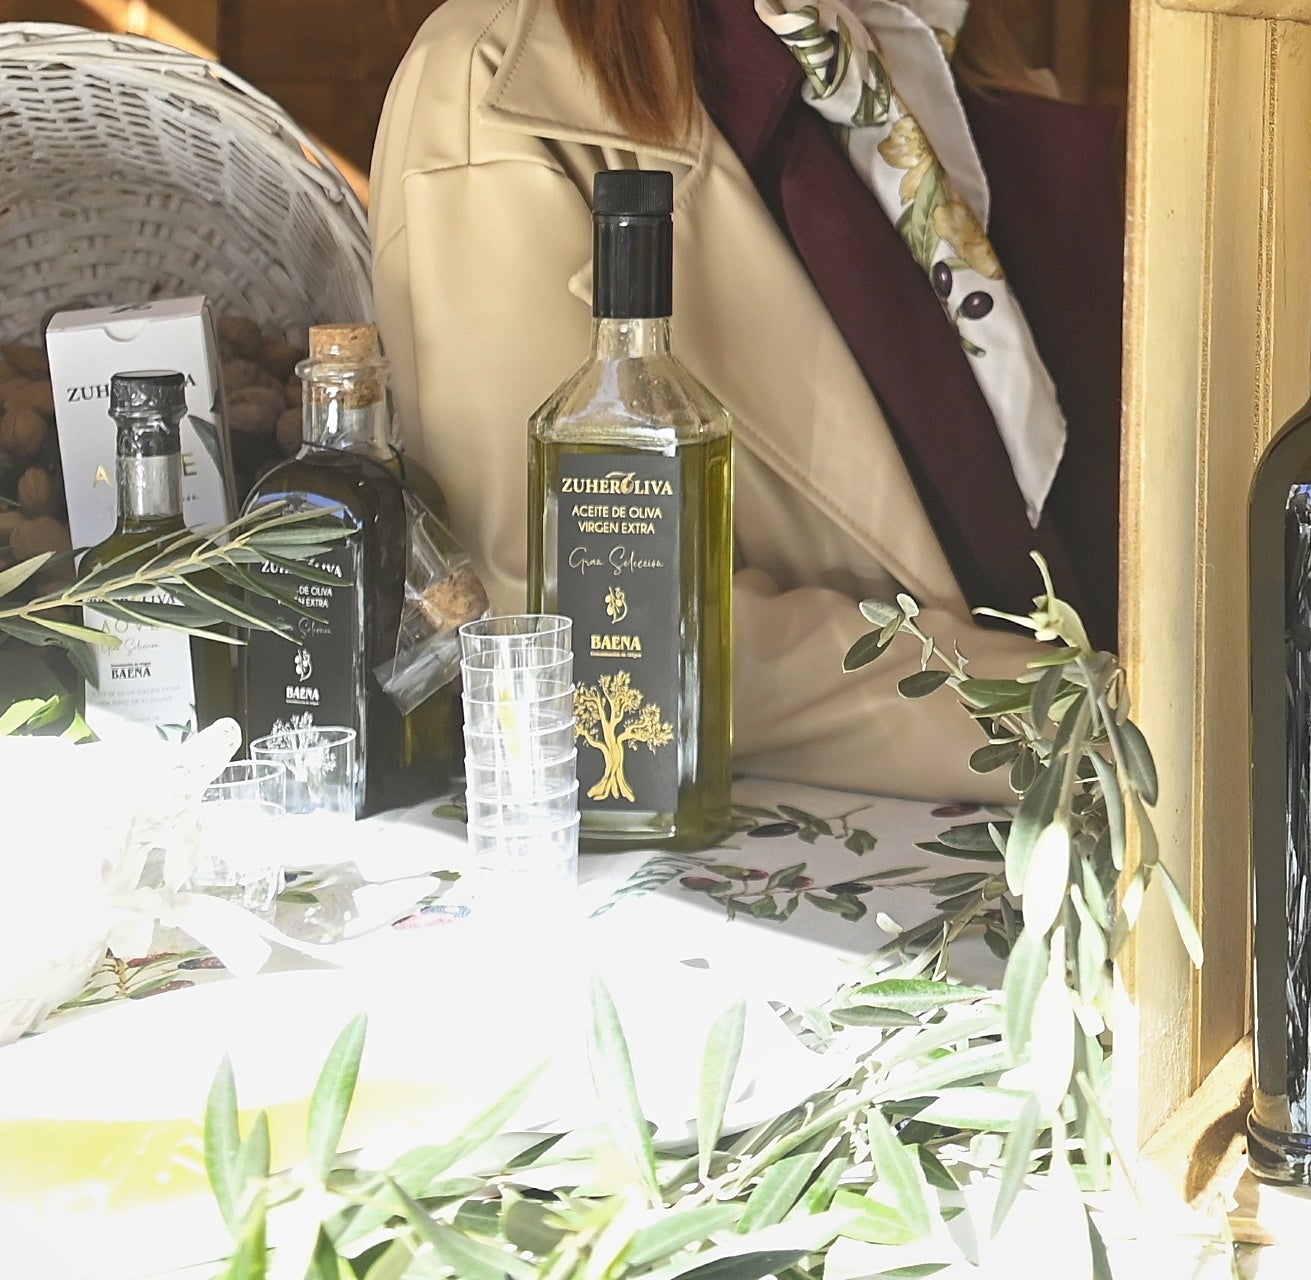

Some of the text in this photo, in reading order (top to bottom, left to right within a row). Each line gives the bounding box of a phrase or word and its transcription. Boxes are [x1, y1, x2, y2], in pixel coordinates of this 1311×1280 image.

[561, 472, 674, 496] ZUHEROLIVA
[572, 505, 663, 520] ACEITE DE OLIVA
[577, 521, 655, 535] VIRGEN EXTRA
[568, 547, 604, 575] Gran
[310, 586, 333, 597] OLIVA
[305, 598, 329, 608] EXTRA
[590, 634, 642, 651] BAENA
[111, 667, 152, 680] BAENA
[286, 686, 320, 701] BAENA
